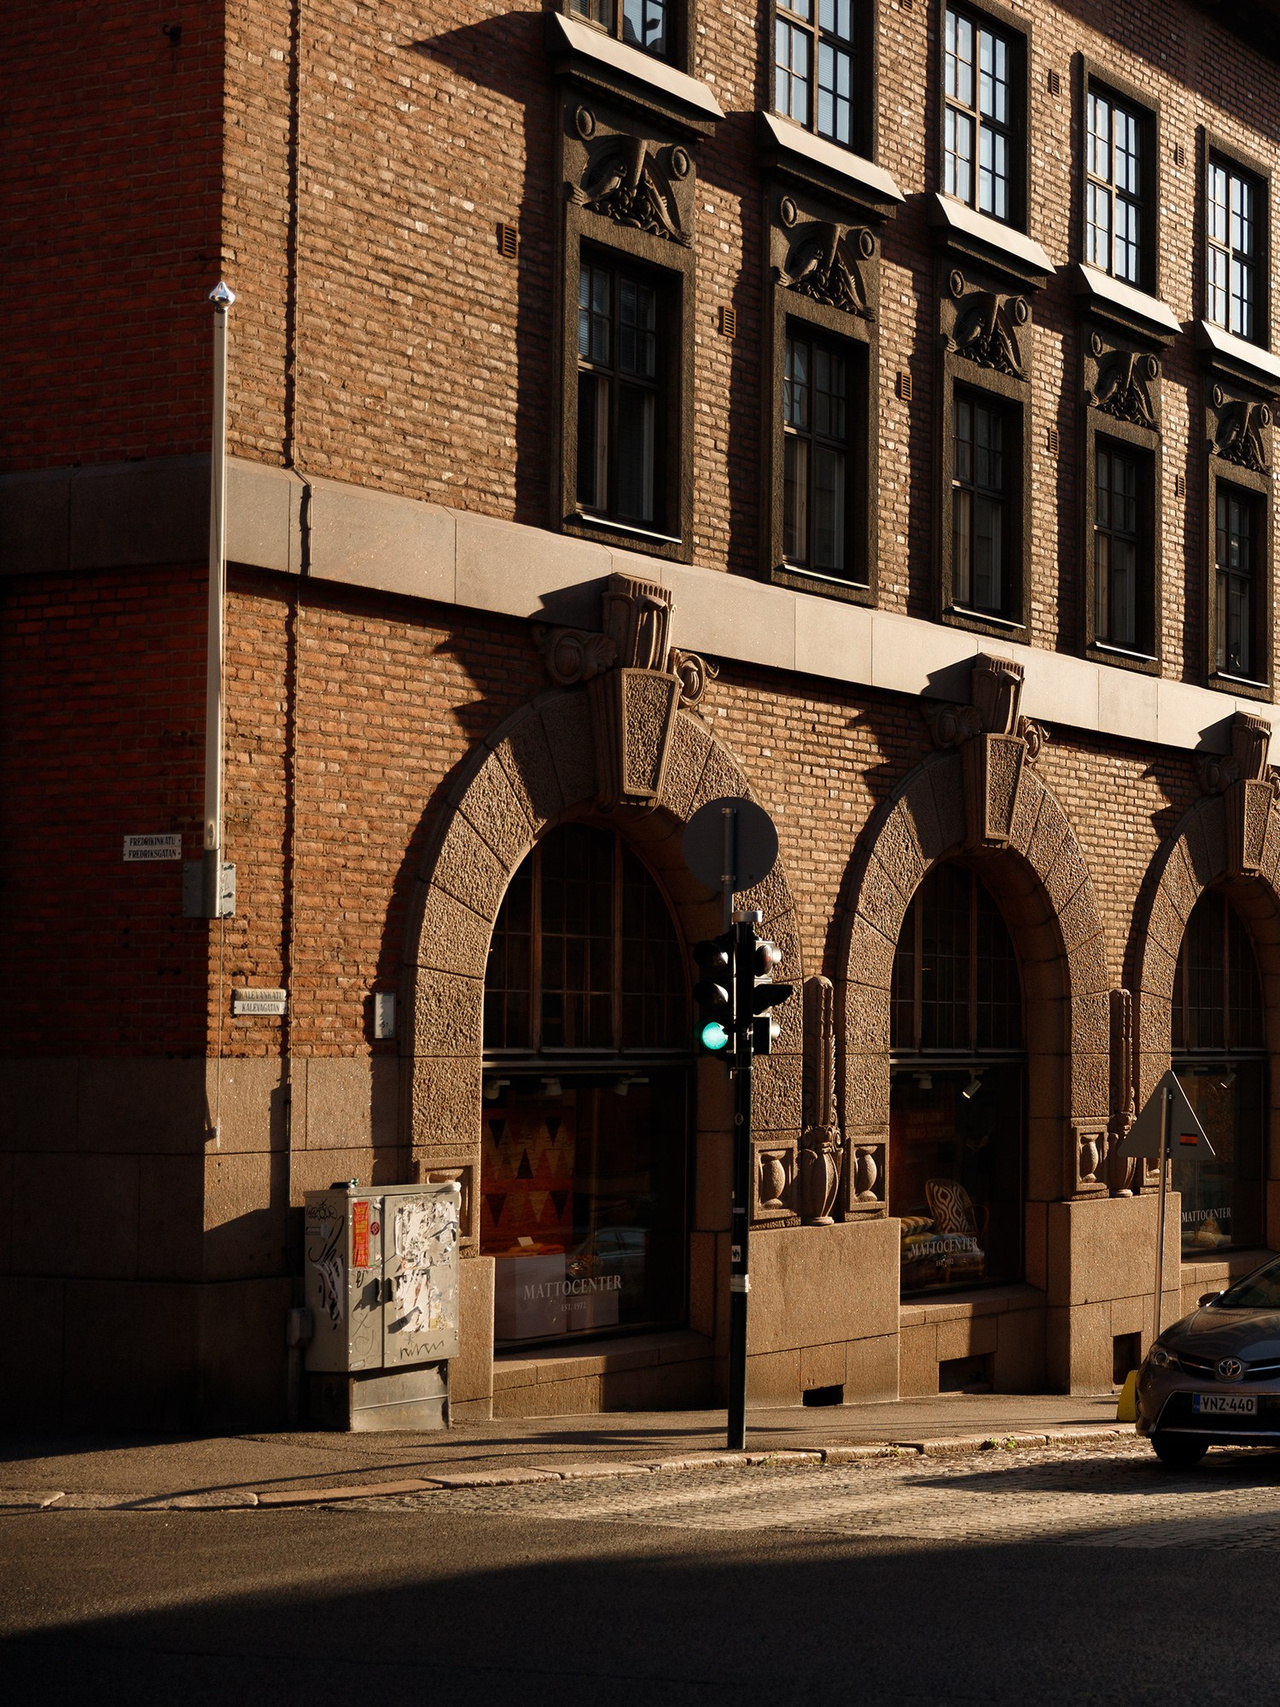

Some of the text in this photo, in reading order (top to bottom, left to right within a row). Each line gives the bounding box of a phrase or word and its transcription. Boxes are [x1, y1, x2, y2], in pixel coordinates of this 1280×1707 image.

[129, 837, 175, 846] FREDRIKINKATU
[128, 849, 177, 859] FREDRIKSGATAN
[239, 990, 283, 999] KALEVANKATU
[242, 1003, 280, 1012] KALEVAGATAN
[1181, 1206, 1231, 1223] MATTOCENTER
[911, 1236, 978, 1256] MATTOCENTER
[523, 1274, 622, 1301] MATTOCENTER
